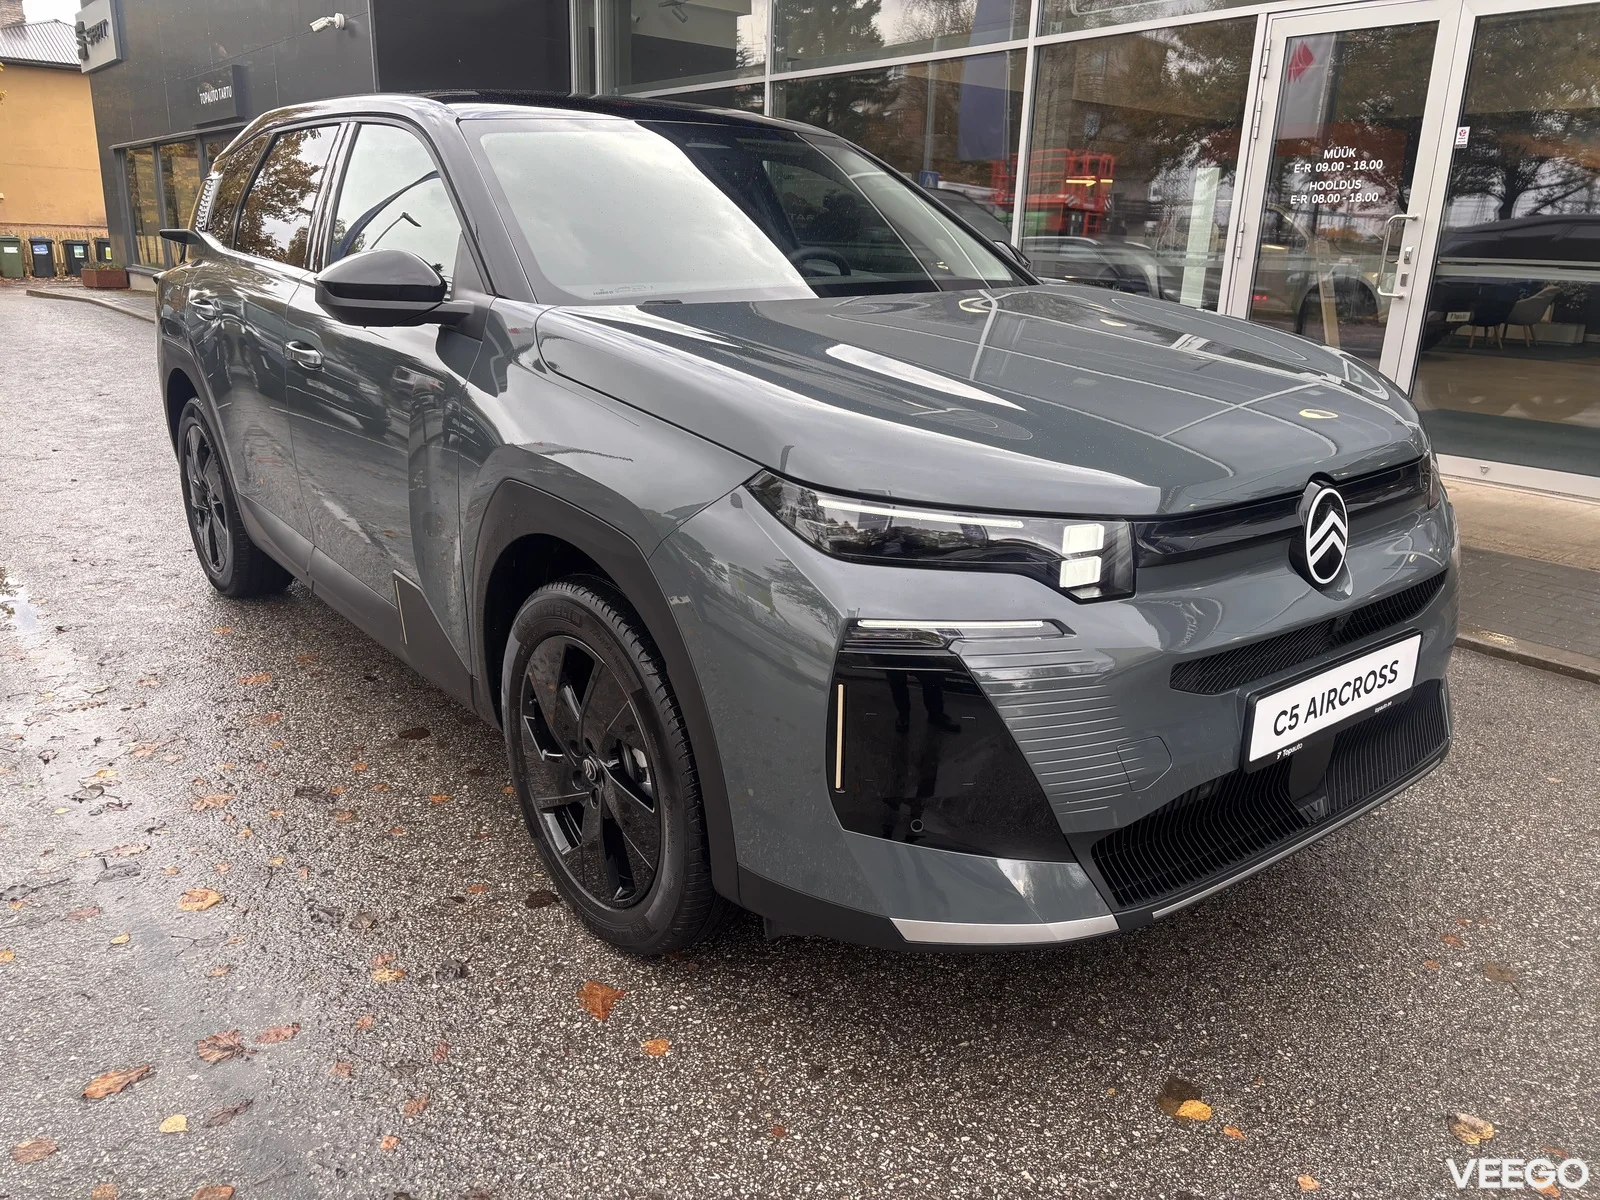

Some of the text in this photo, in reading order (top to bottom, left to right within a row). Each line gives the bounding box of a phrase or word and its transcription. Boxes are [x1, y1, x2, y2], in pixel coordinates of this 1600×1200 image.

[200, 85, 232, 105] TOPAUTO TARTU
[1323, 146, 1357, 159] MÜÜK
[1293, 163, 1312, 174] E-R
[1315, 161, 1345, 173] 09.00
[1353, 159, 1384, 171] 18.00
[1309, 180, 1362, 191] HOOLDUS
[1290, 194, 1308, 205] E-R
[1311, 193, 1341, 204] 08.00
[1349, 192, 1379, 203] 18.00
[1273, 659, 1399, 737] C5 AIRCROSS
[1283, 742, 1303, 757] Topauto
